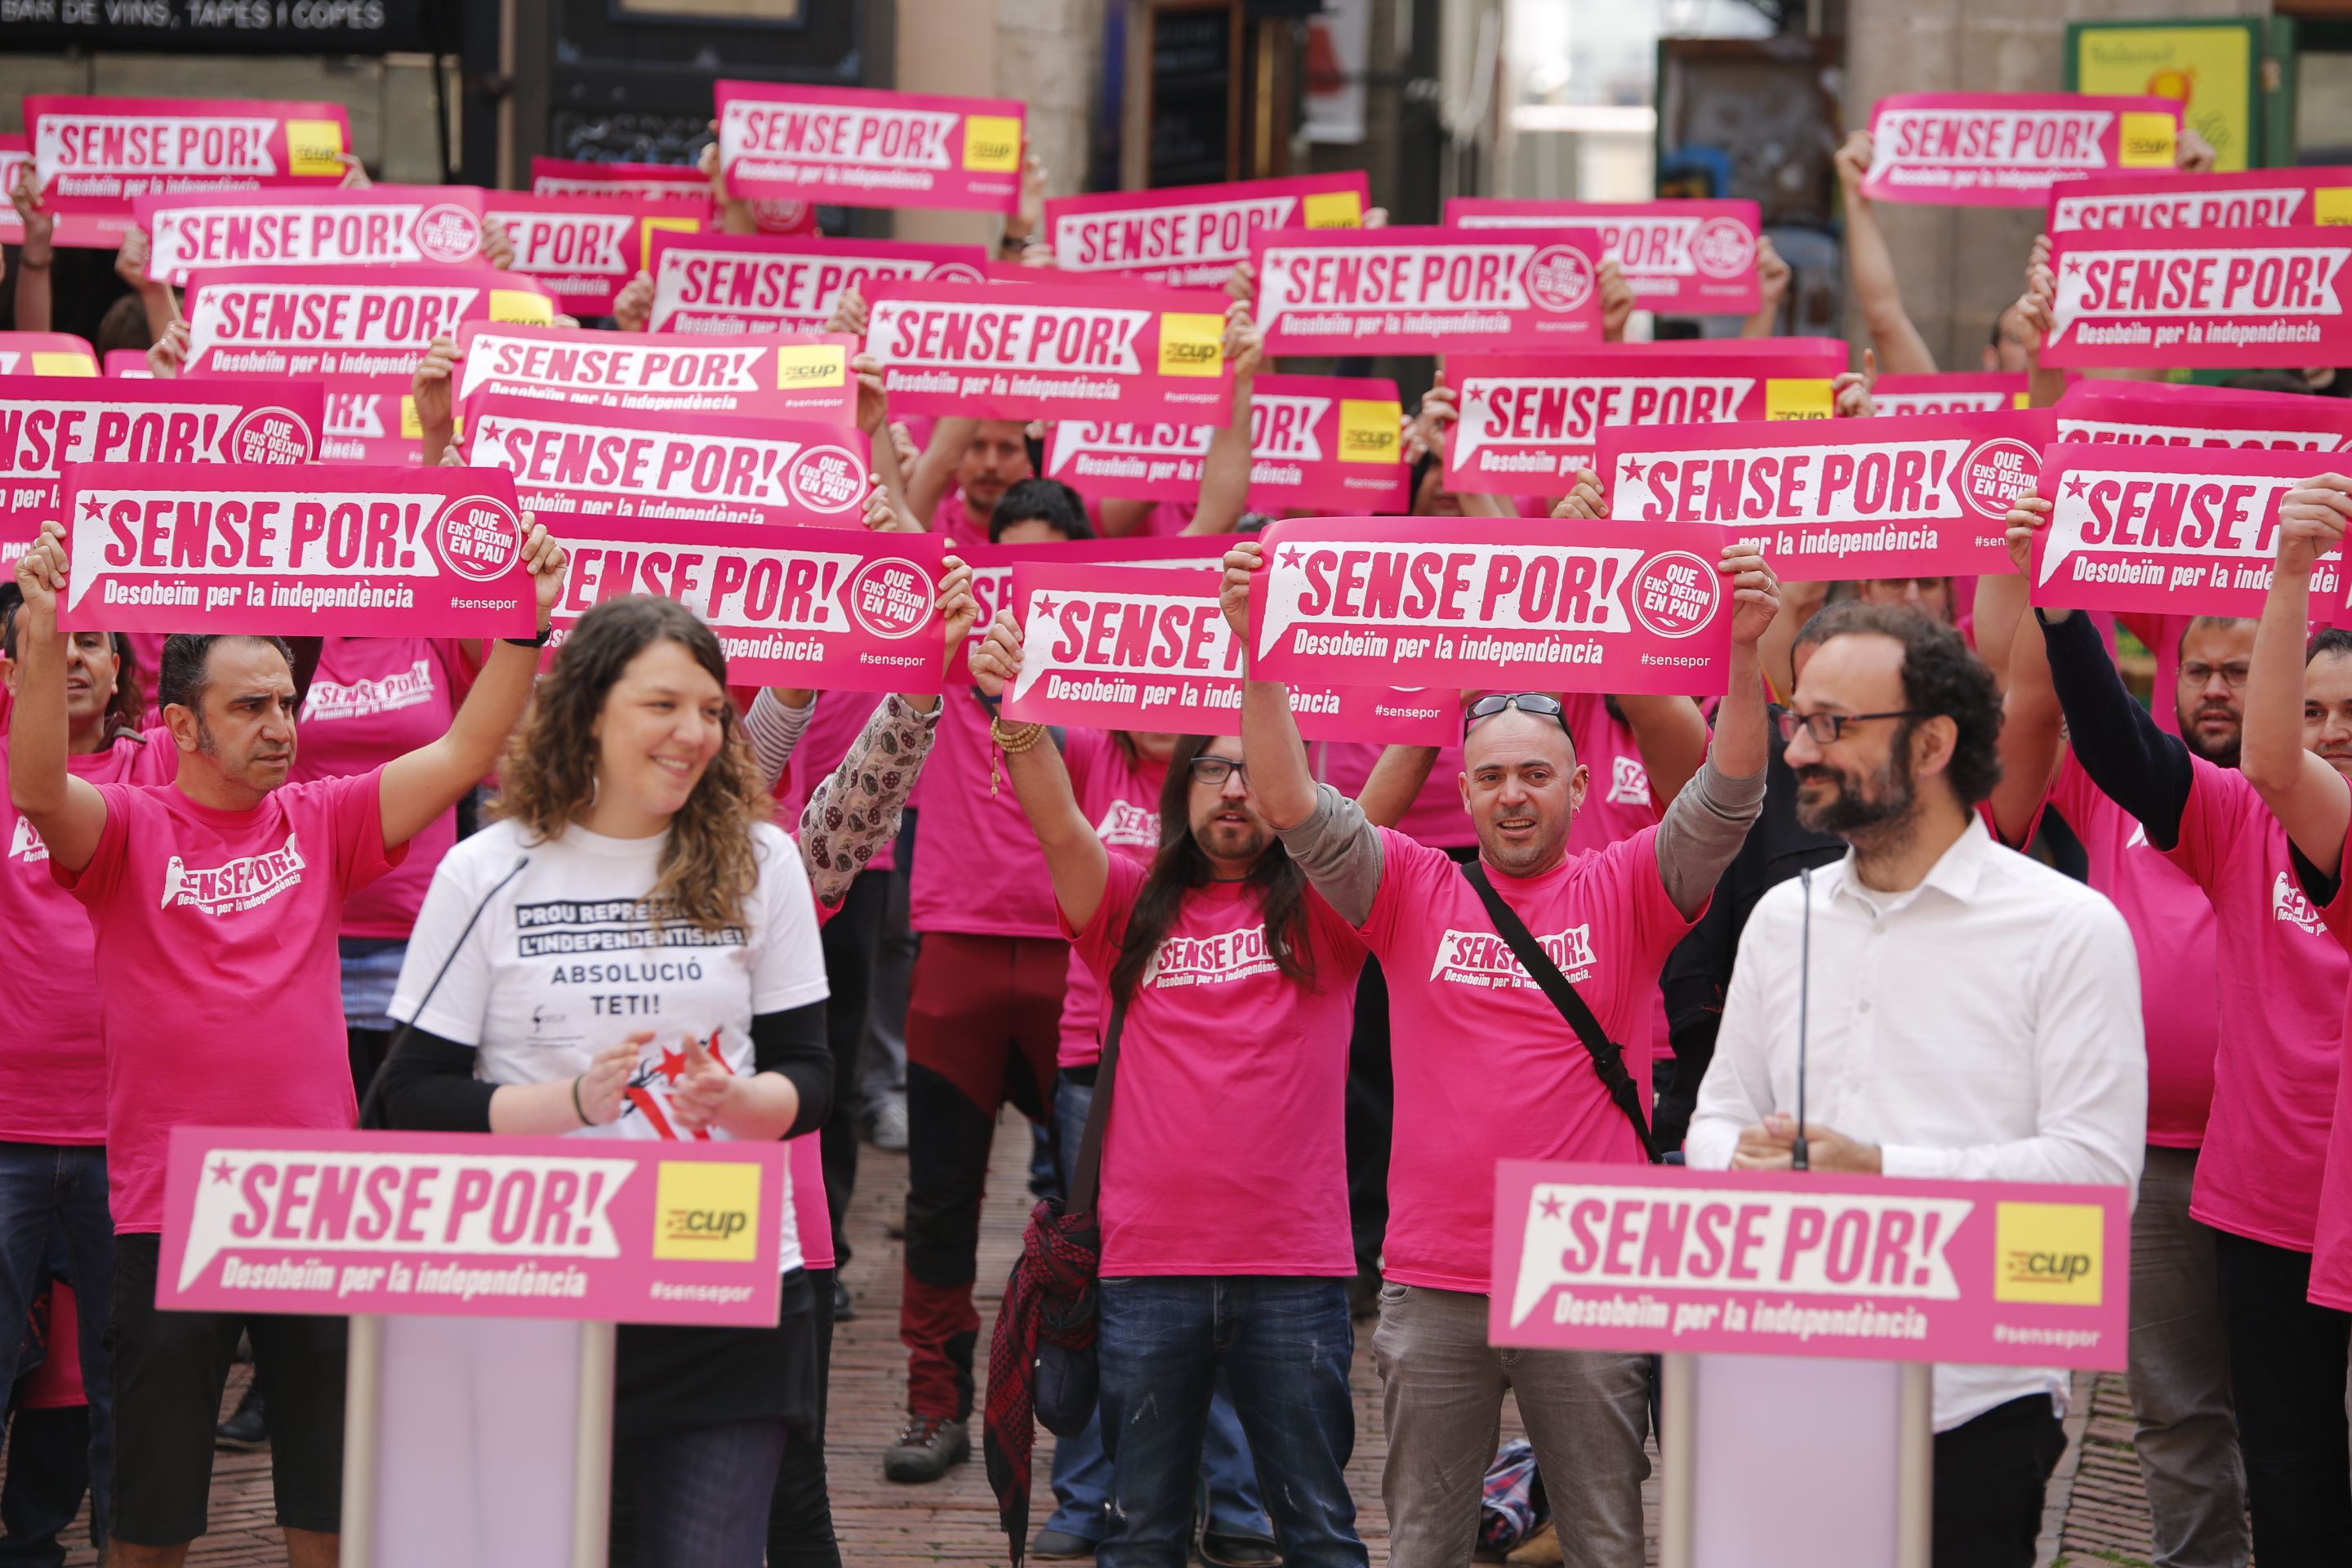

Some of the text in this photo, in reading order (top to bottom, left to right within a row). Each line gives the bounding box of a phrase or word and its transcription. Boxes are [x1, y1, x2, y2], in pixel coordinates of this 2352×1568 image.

[0, 0, 385, 30] BAR DE VINS, TAPES COPES
[58, 124, 261, 167] SENSE POR!
[743, 109, 940, 160] SENSE POR!
[1895, 117, 2099, 159] SENSE POR!
[176, 215, 301, 261] SENSE
[310, 214, 405, 258] POR!
[528, 222, 615, 265] POR!
[1080, 215, 1187, 265] SENSE
[680, 259, 808, 309] SENSE
[1285, 256, 1411, 305] SENSE
[1418, 254, 1517, 303] POR!
[2080, 256, 2331, 310] SENSE POR!
[216, 292, 460, 341] SENSE POR!
[889, 309, 1131, 366] SENSE POR!
[2075, 318, 2321, 349] Desobeïm per la independència
[212, 350, 336, 378] Desobeïm per la
[492, 343, 749, 388] SENSE POR!
[1178, 343, 1217, 363] cup
[885, 368, 1122, 402] Desobeïm per la independència
[620, 392, 738, 413] independència
[1485, 385, 1622, 441] SENSE
[92, 412, 220, 463] POR!
[243, 430, 266, 449] ENS
[266, 435, 305, 458] DEIXIN
[263, 417, 294, 441] QUE
[243, 445, 265, 464] EN
[500, 428, 779, 498] SENSE POR!
[819, 455, 849, 474] QUE
[1075, 454, 1193, 483] Desobeïm per la
[1480, 449, 1557, 474] Desobeïm
[1993, 450, 2025, 472] QUE
[799, 479, 850, 503] EN PAU
[800, 464, 858, 492] ENS DEIXIN
[1642, 449, 1949, 522] SENSE POR!
[1971, 463, 2038, 488] ENS DEIXIN
[1973, 478, 1998, 497] EN
[11, 488, 47, 514] per
[617, 498, 633, 518] la
[2080, 479, 2257, 550] SENSE
[104, 499, 422, 569] SENSE POR!
[468, 508, 501, 531] QUE
[447, 521, 514, 550] ENS DEIXIN
[449, 536, 505, 564] EN PAU
[1775, 525, 1939, 559] la independència
[883, 568, 915, 590] QUE
[1297, 549, 1619, 624] SENSE POR!
[1665, 563, 1699, 586] QUE
[2072, 555, 2166, 586] Desobeïm
[2168, 564, 2206, 592] per
[2210, 562, 2229, 590] la
[103, 578, 414, 613] Desobeïm per la independència
[449, 595, 519, 612] #sensepor
[706, 556, 840, 624] POR!
[862, 579, 927, 610] ENS DEIXIN
[1642, 576, 1711, 607] ENS DEIXIN
[862, 595, 918, 624] EN PAU
[1643, 593, 1702, 622] EN PAU
[1051, 600, 1222, 671] SENSE
[1293, 628, 1605, 668] Desobeïm per la independència
[859, 652, 927, 667] #sensepor
[1640, 654, 1712, 669] #sensepor
[1046, 675, 1199, 710] Desobeïm per la
[1374, 704, 1441, 720] #sensepor
[216, 871, 302, 917] per la independència
[517, 902, 577, 928] PROU
[1157, 939, 1226, 970] SENSE
[550, 956, 703, 985] ABSOLUCIÓ
[1156, 973, 1223, 989] Desobeïm per la
[1444, 968, 1521, 990] Desobeïm per la
[590, 993, 661, 1015] TETI!
[230, 1162, 606, 1246] SENSE POR!
[684, 1208, 748, 1240] cup
[1561, 1197, 1944, 1288] SENSE POR!
[220, 1256, 587, 1302] Desobeïm per la independència
[2028, 1247, 2092, 1284] cup
[649, 1280, 754, 1305] #sensepor
[1552, 1290, 1928, 1343] Desobeïm per la independència
[1993, 1323, 2101, 1348] #sensepor
